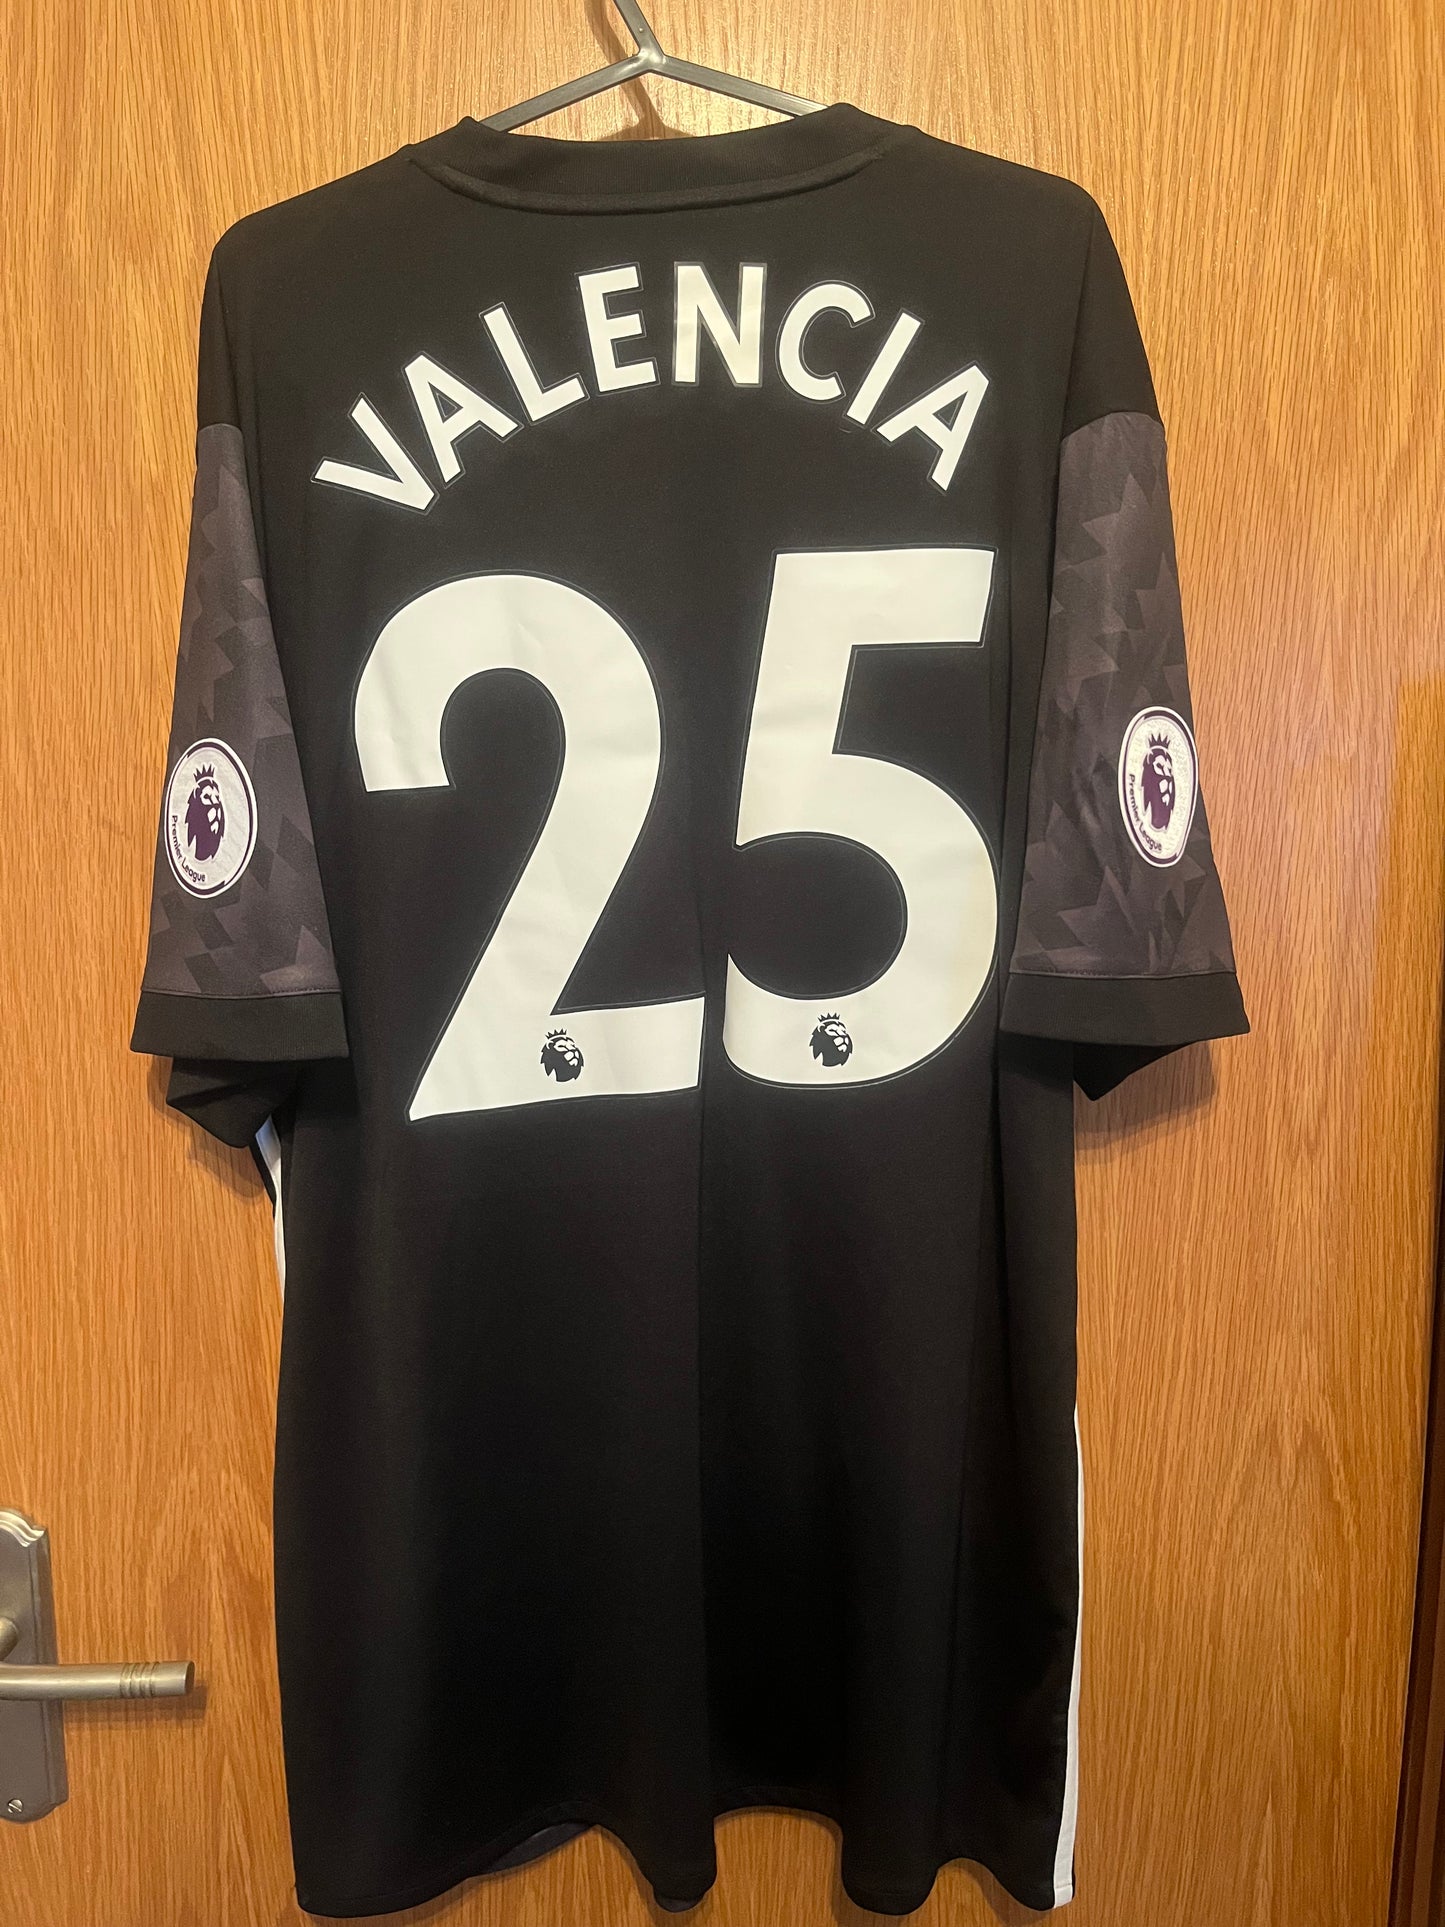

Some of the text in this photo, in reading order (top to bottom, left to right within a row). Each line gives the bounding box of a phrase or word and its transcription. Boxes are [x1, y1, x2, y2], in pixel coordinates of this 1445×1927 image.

[315, 263, 989, 510] VALENCIA
[171, 815, 206, 883] Premier League
[355, 548, 997, 1121] 25
[1128, 773, 1162, 852] Premier League
